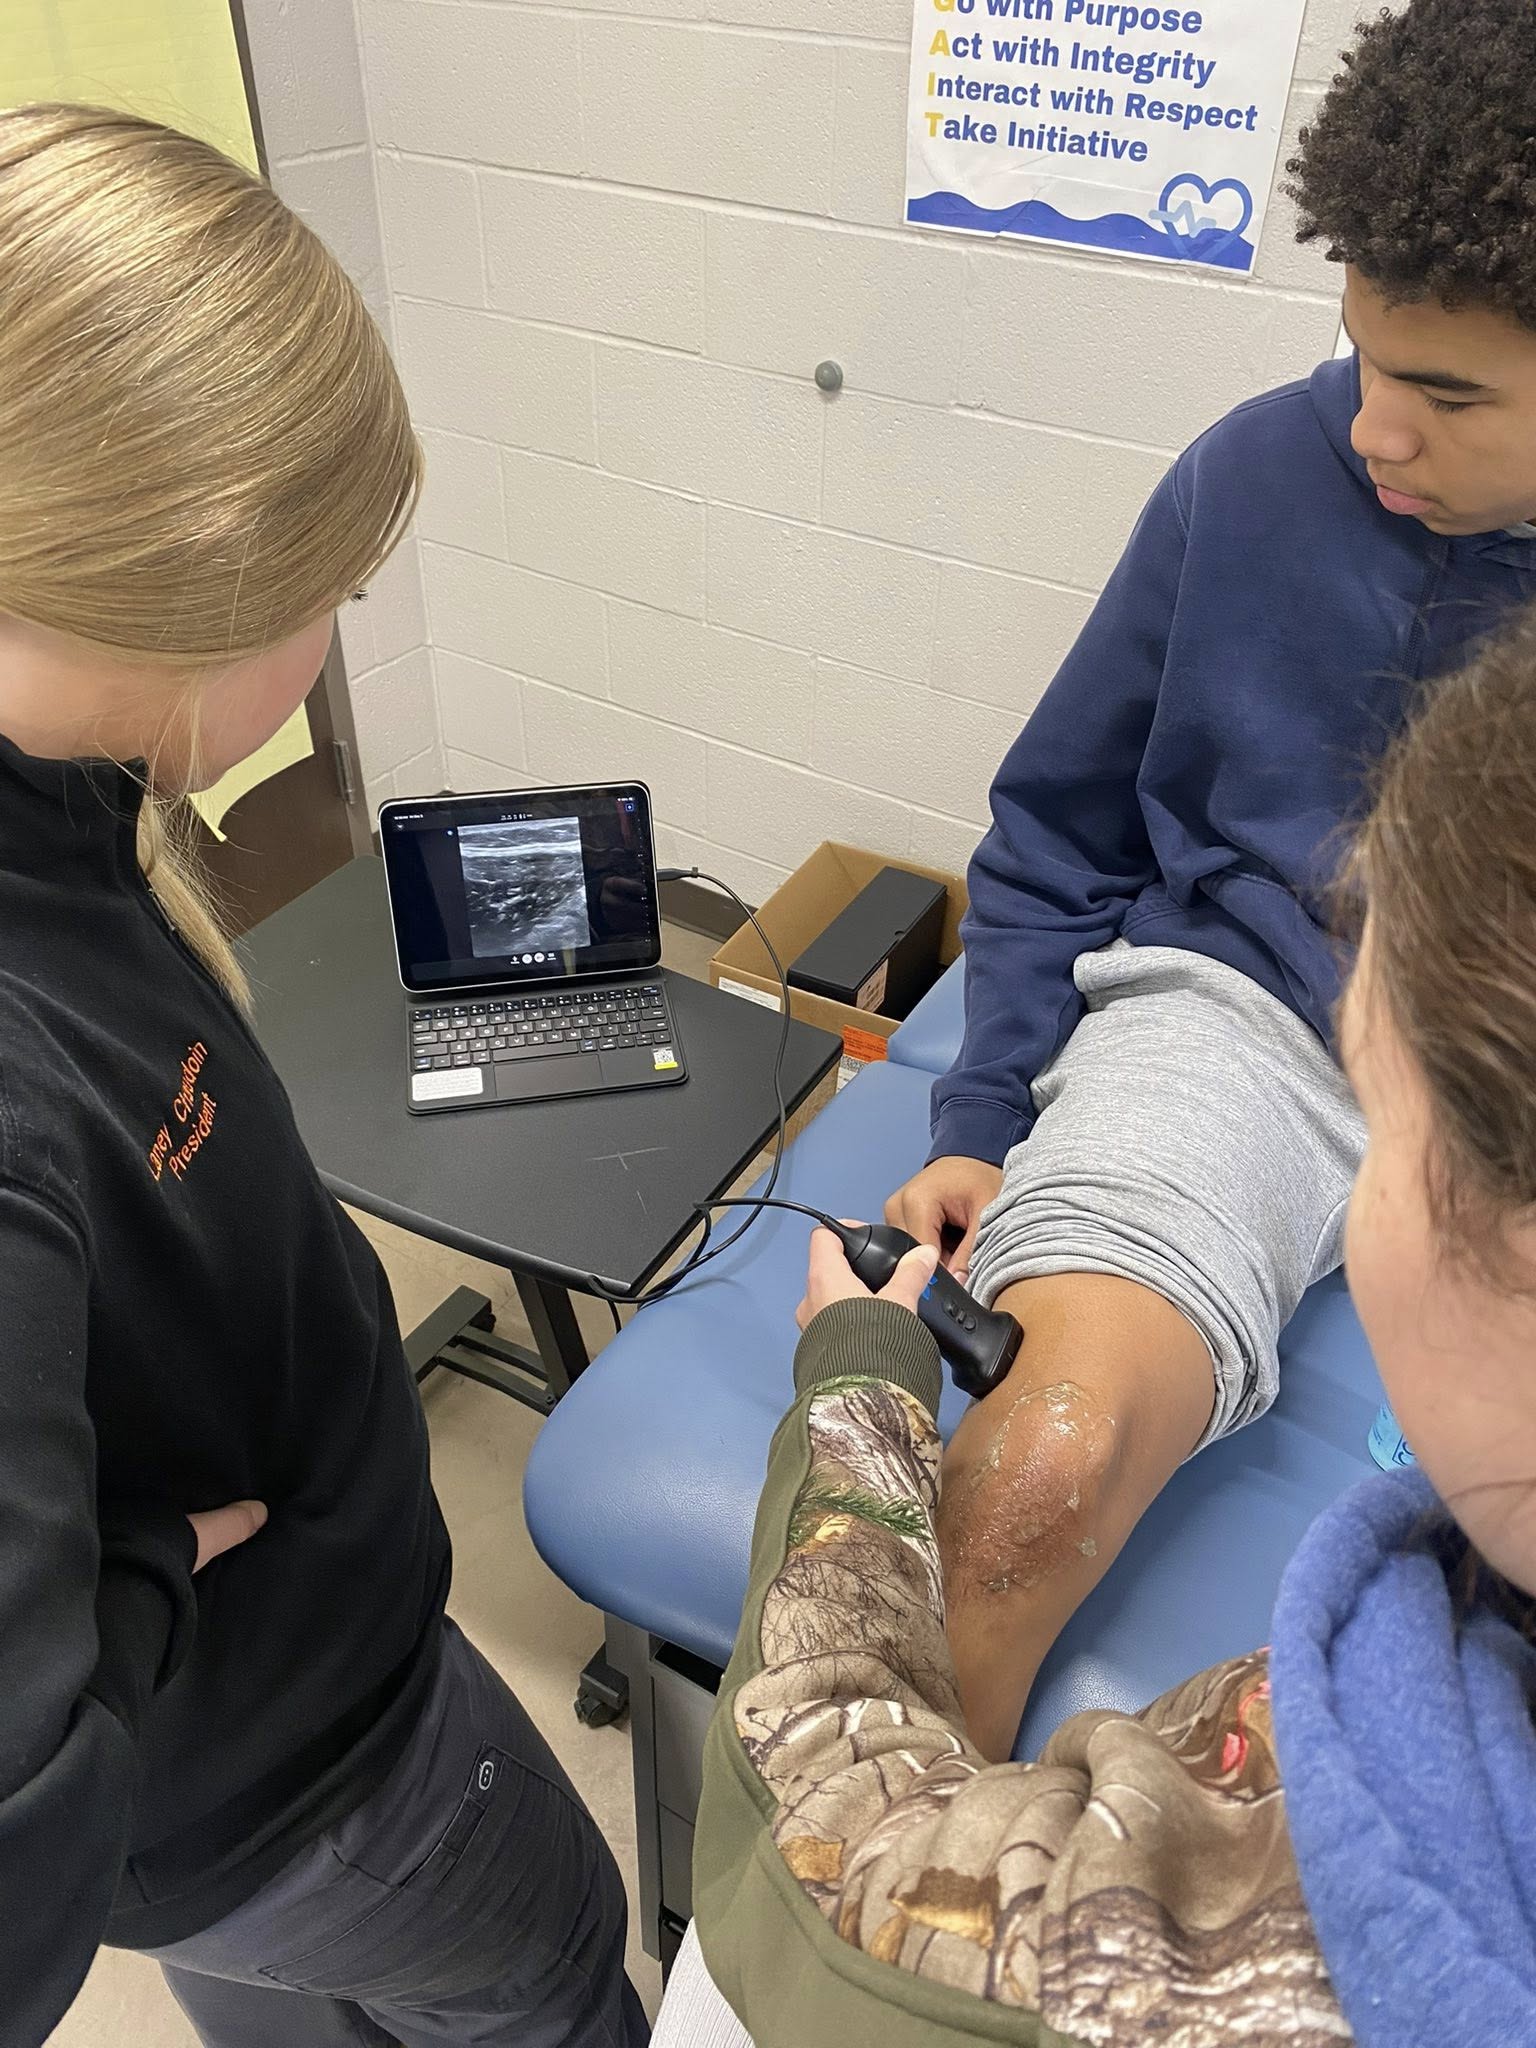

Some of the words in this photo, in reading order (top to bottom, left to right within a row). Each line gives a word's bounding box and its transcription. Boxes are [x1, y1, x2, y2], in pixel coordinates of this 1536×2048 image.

[986, 0, 1053, 21] with
[1064, 0, 1203, 35] Purpose
[929, 29, 983, 60] Act
[992, 35, 1060, 67] with
[1070, 42, 1217, 89] Integrity
[927, 71, 1041, 108] Interact
[1050, 86, 1114, 116] with
[1124, 92, 1258, 131] Respect
[924, 111, 997, 144] Take
[1007, 121, 1148, 162] Initiative
[146, 1122, 173, 1181] Laney
[169, 1091, 217, 1181] President
